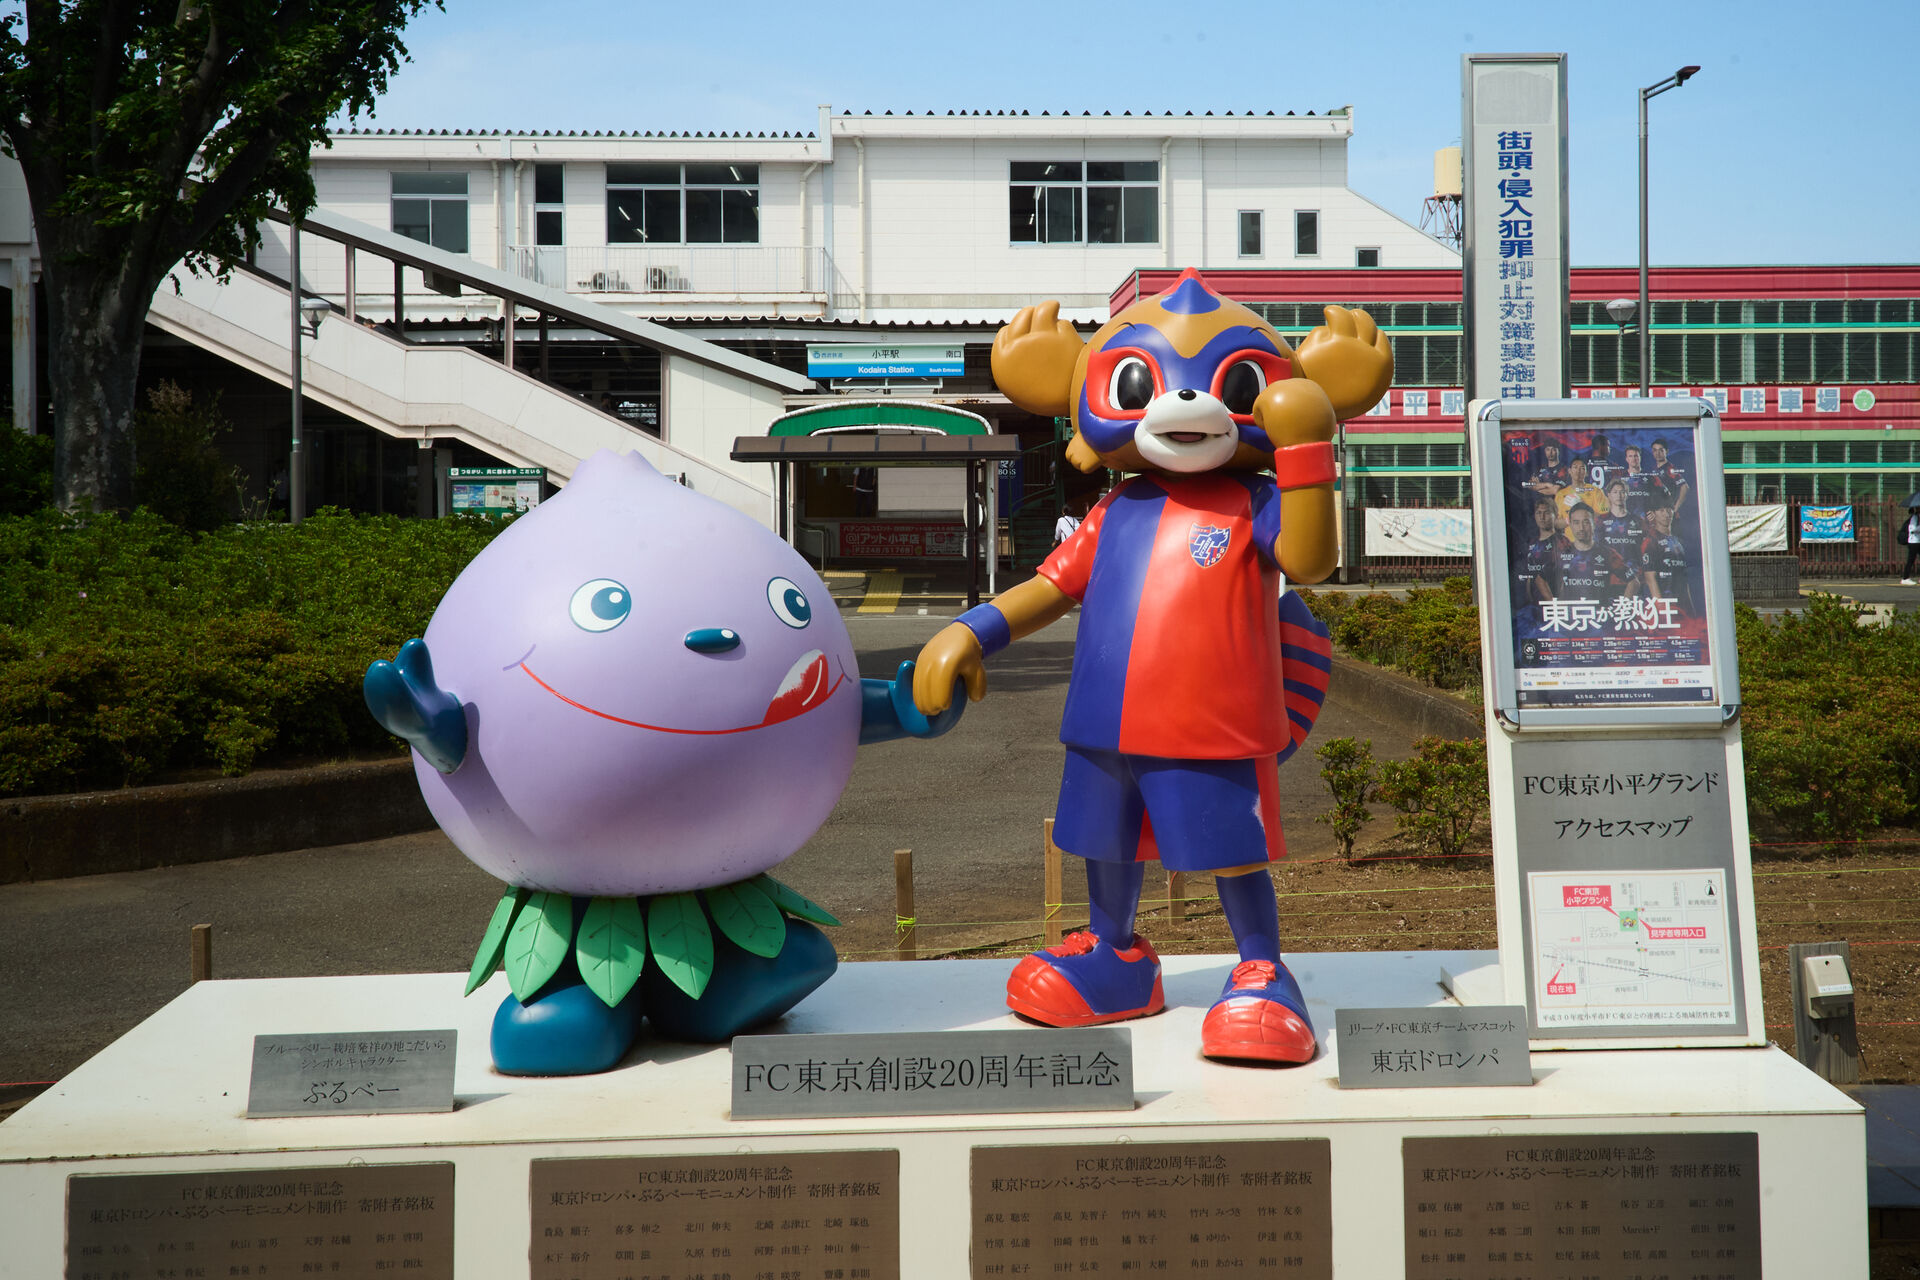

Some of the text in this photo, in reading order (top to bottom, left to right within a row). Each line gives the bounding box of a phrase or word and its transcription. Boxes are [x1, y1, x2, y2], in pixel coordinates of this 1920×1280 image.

[872, 350, 899, 359] 小平駅
[946, 350, 961, 358] 南口
[858, 366, 887, 374] Kodaira
[888, 366, 914, 374] Station
[1591, 466, 1605, 489] 9
[1567, 578, 1592, 586] TOKYO
[1538, 596, 1681, 632] 東京が熱狂
[1523, 772, 1719, 796] FC東京小平グランド
[1554, 815, 1693, 839] アクセスマップ
[1573, 887, 1600, 896] FC東京
[1566, 896, 1609, 905] 小平グランド
[1650, 928, 1704, 938] 見学者専用入口
[1549, 985, 1574, 994] 現在地
[264, 1039, 446, 1056] ブルーベリー栽培発祥の地こだいら
[301, 1057, 407, 1070] シンボルキャラクター
[1370, 1048, 1499, 1074] 東京ドロンパ
[744, 1051, 1120, 1094] FC東京創設20周年記念
[302, 1081, 399, 1103] ぶるべー
[1506, 1147, 1655, 1163] FC東京創設20周年記念
[1076, 1155, 1226, 1172] FC東京創設20周年記念
[1670, 1164, 1741, 1179] 寄附者銘板
[639, 1167, 792, 1184] FC東京創設20周年記念
[991, 1171, 1312, 1192] 東京ドロンパ・ぶるべーモニュメント制作 寄附者銘板
[181, 1181, 343, 1201] FC東京創設20周年記念
[551, 1182, 880, 1206] 東京ドロンパ・ぶるべーモニュメント制作 寄附者銘板
[1081, 1211, 1106, 1220] 美智子
[1122, 1210, 1140, 1219] 竹内
[1190, 1208, 1208, 1218] 竹内
[1216, 1208, 1240, 1217] みづき
[1258, 1207, 1276, 1216] 竹林
[616, 1225, 634, 1235] 喜多
[685, 1223, 704, 1232] 北川
[781, 1219, 809, 1230] 志津江
[1080, 1236, 1098, 1246] 哲也
[1258, 1232, 1276, 1241] 伊達
[545, 1253, 563, 1263] 木下
[754, 1246, 774, 1256] 河野
[781, 1245, 808, 1255] 由里子
[825, 1244, 843, 1253] 神山
[986, 1264, 1004, 1273] 田村
[1054, 1262, 1072, 1272] 田村
[1150, 1260, 1167, 1269] 大樹
